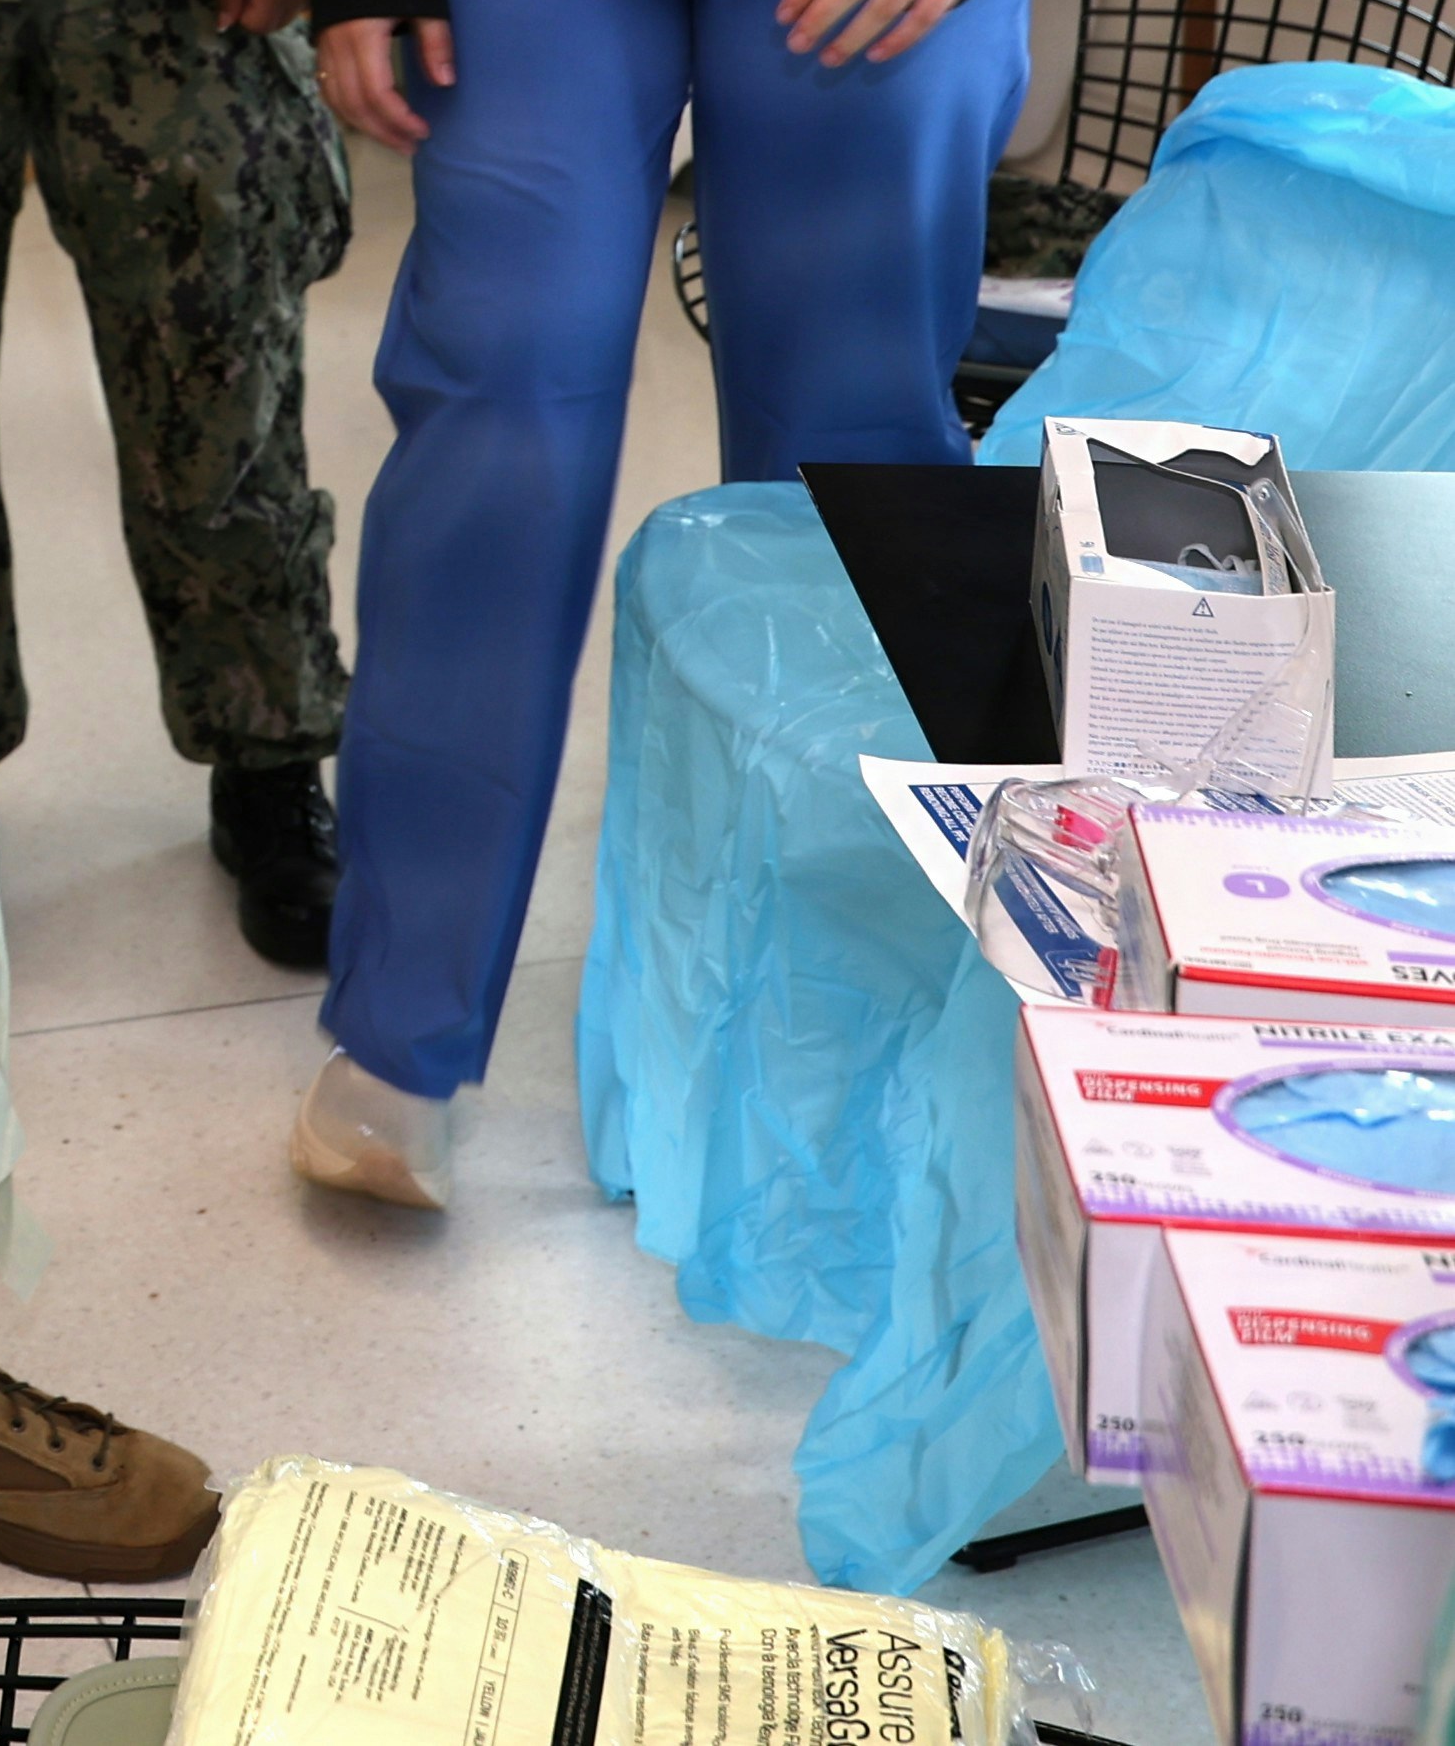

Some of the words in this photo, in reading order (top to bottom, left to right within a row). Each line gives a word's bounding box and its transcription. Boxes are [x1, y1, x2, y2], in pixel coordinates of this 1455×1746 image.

[1252, 1023, 1377, 1042] NITRILE
[1082, 1077, 1203, 1098] DISPENSING
[1236, 1315, 1372, 1342] DISPENSING
[1096, 1414, 1136, 1432] 250
[761, 1628, 777, 1651] Con
[762, 1654, 777, 1662] la
[878, 1632, 920, 1743] Assure
[480, 1682, 495, 1718] YELLOW
[1259, 1702, 1305, 1724] 250
